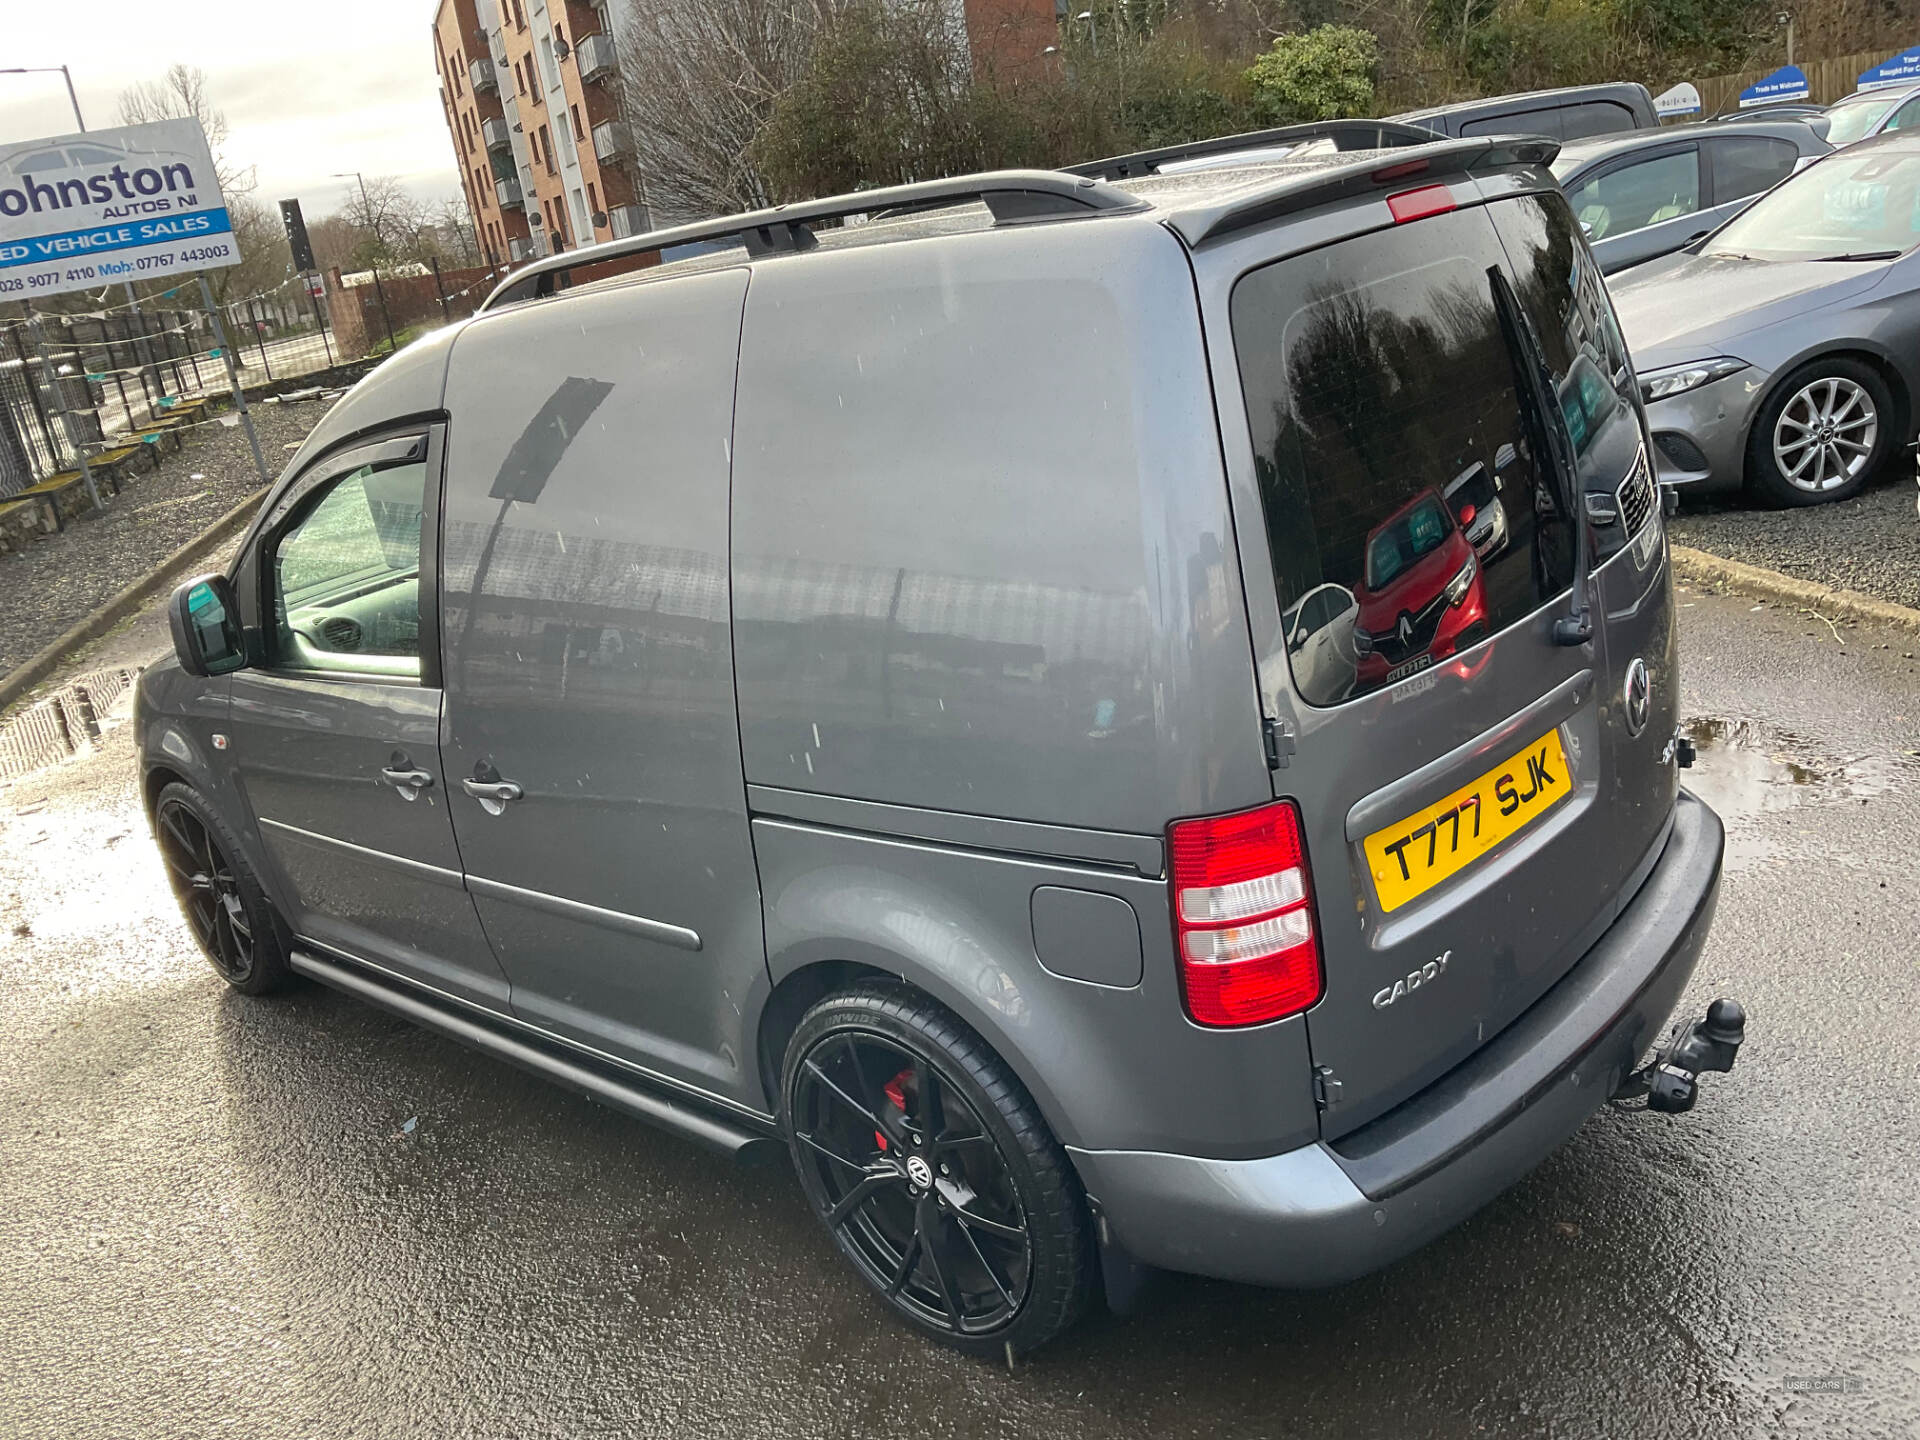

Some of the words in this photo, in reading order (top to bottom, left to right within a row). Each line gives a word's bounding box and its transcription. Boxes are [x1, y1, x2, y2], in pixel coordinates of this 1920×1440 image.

[1779, 81, 1804, 89] Welcome
[102, 198, 171, 220] AUTOS
[178, 194, 198, 208] NI
[36, 228, 133, 255] VEHICLE
[140, 216, 210, 239] SALES
[0, 277, 24, 292] 028
[27, 272, 60, 288] 9077
[66, 266, 95, 282] 4110
[97, 260, 135, 277] Mob:
[136, 253, 174, 271] 07767
[180, 244, 230, 263] 443003
[1384, 792, 1481, 882] T777
[1495, 746, 1555, 817] SJK
[1372, 950, 1452, 1010] CADDY
